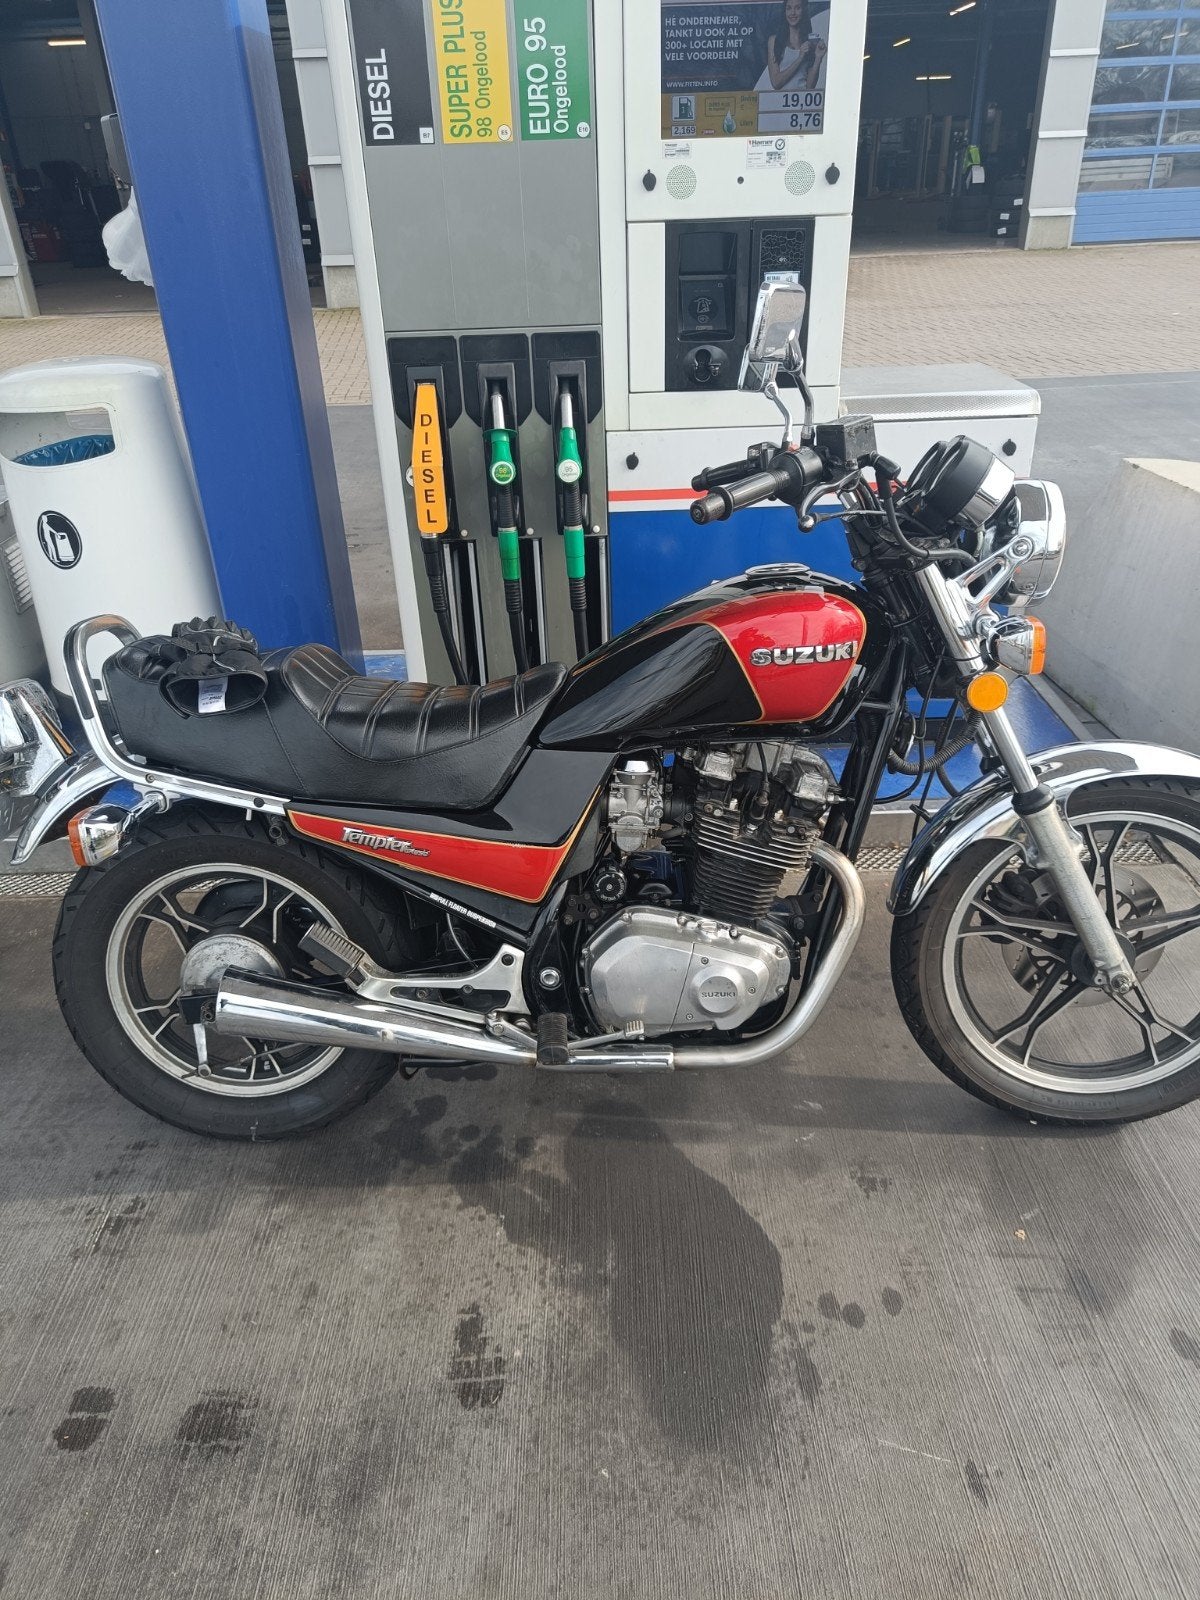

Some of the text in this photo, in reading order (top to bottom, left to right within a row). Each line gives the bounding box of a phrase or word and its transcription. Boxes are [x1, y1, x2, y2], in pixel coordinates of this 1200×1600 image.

[665, 15, 742, 26] HÉ ONDERNEMER,
[665, 27, 753, 38] TANKT U OOK AL OP
[665, 39, 743, 50] 300+ LOCATIE MET
[665, 50, 738, 61] VELE VOORDELEN
[470, 30, 492, 137] 98 Ongelood
[523, 17, 550, 134] EURO 95
[365, 48, 394, 139] DIESEL
[550, 45, 571, 133] Ongelood
[445, 64, 472, 138] SUPER
[782, 92, 822, 110] 19,00
[674, 126, 696, 136] 2,169
[790, 113, 821, 130] 8,76
[420, 413, 437, 524] DIESEL
[750, 640, 858, 667] SUZUKI
[342, 826, 412, 853] Tempter
[437, 896, 449, 907] FULL
[447, 900, 468, 915] FLOATER
[701, 990, 736, 999] SUZUKI
